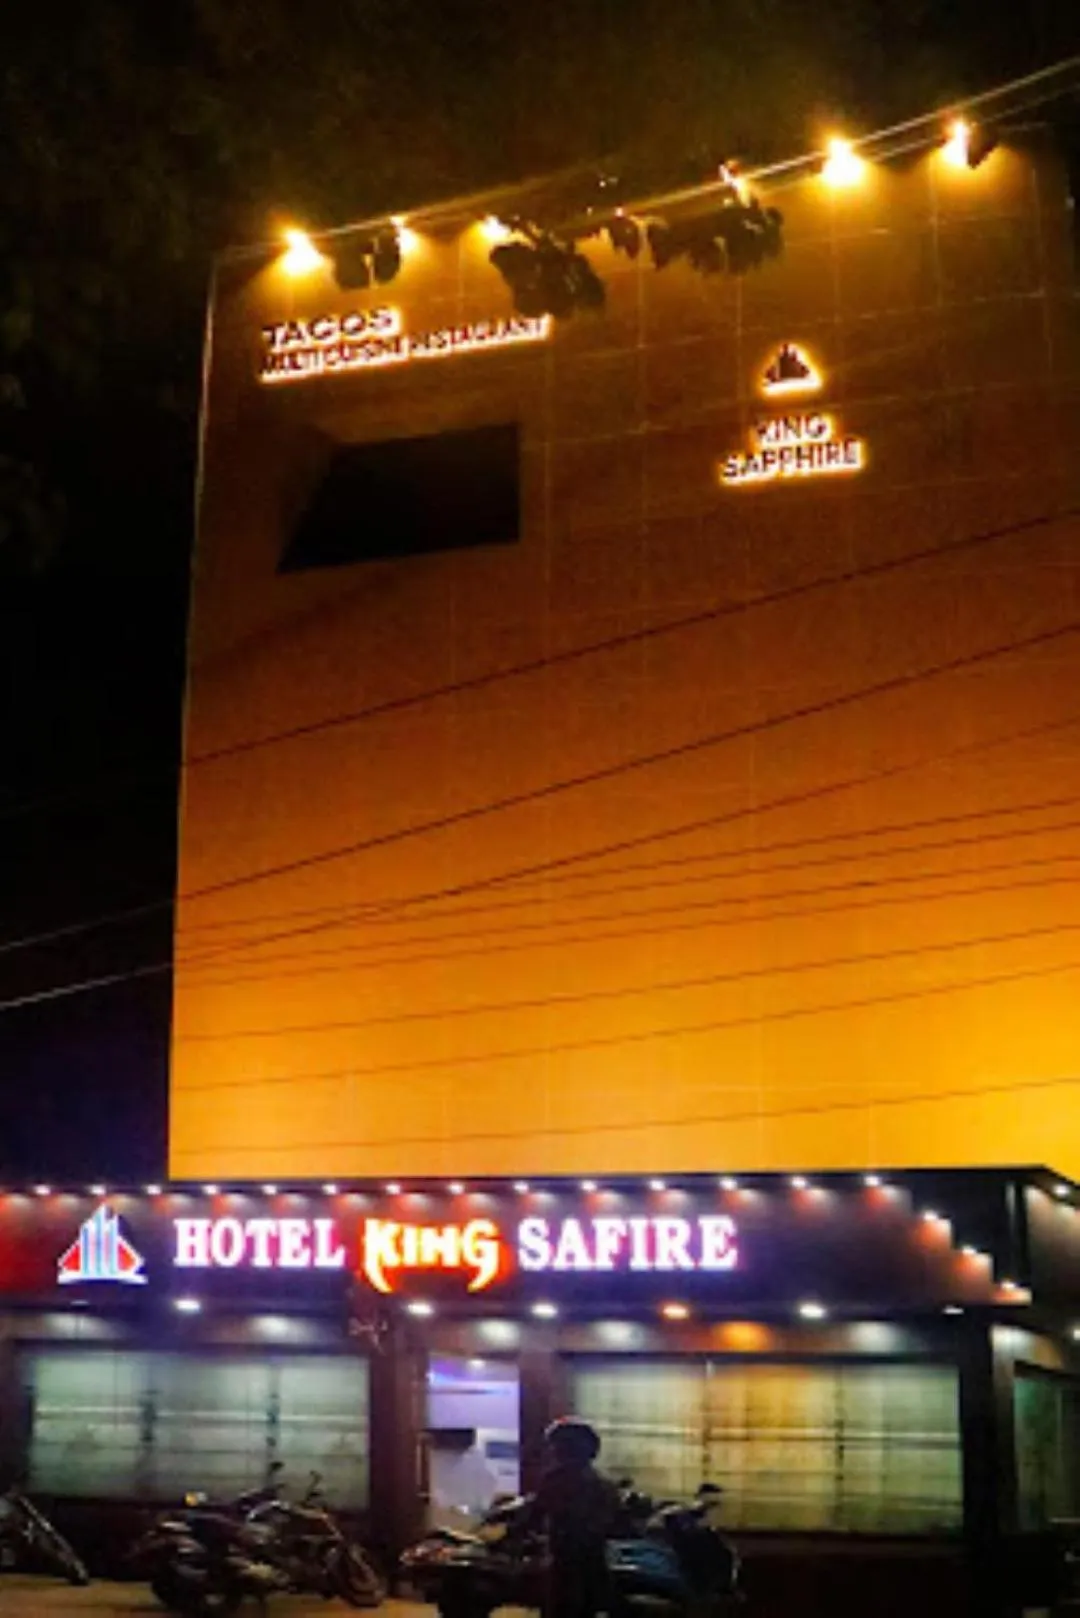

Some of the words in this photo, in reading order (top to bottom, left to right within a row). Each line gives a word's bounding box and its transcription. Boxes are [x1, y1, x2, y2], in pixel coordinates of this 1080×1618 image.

[753, 413, 833, 447] KING
[720, 438, 865, 485] SAPPHIRE
[173, 1217, 345, 1268] HOTEL
[363, 1218, 500, 1293] KING
[517, 1215, 740, 1271] SAFIRE
